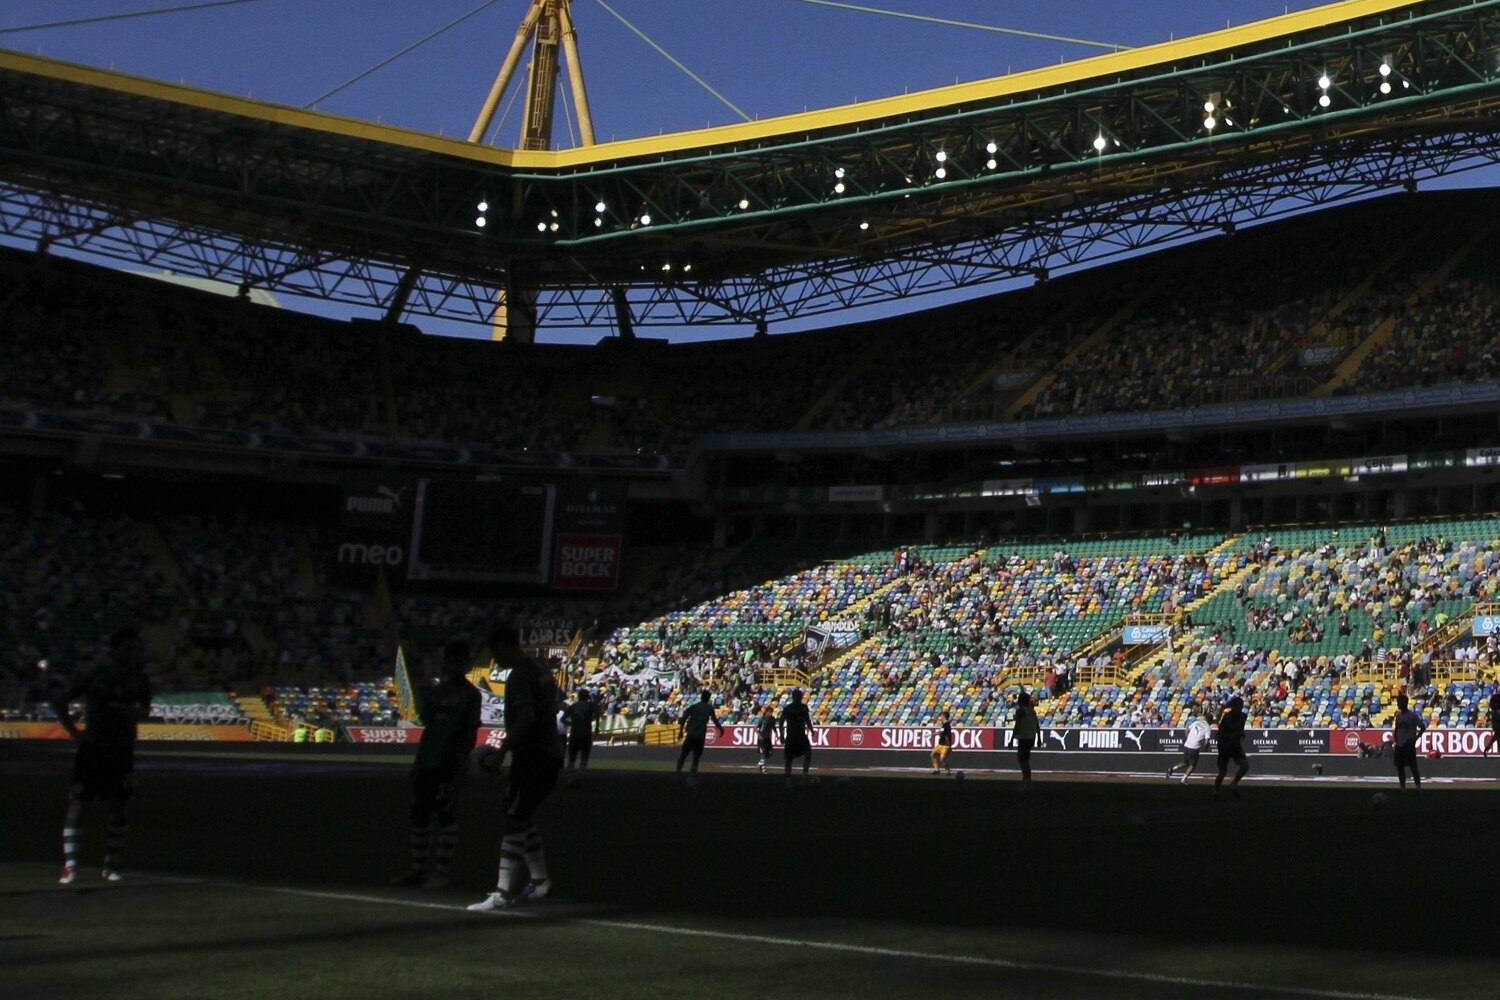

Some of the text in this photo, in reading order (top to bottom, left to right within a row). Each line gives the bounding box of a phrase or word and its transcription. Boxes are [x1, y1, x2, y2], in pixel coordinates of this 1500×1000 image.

[347, 496, 392, 513] PUMA
[337, 543, 402, 566] meo
[561, 546, 614, 562] SUPER
[560, 562, 611, 578] BOCK
[360, 729, 408, 738] SUPER
[881, 728, 932, 748] SUPER
[1079, 730, 1119, 748] PUMA
